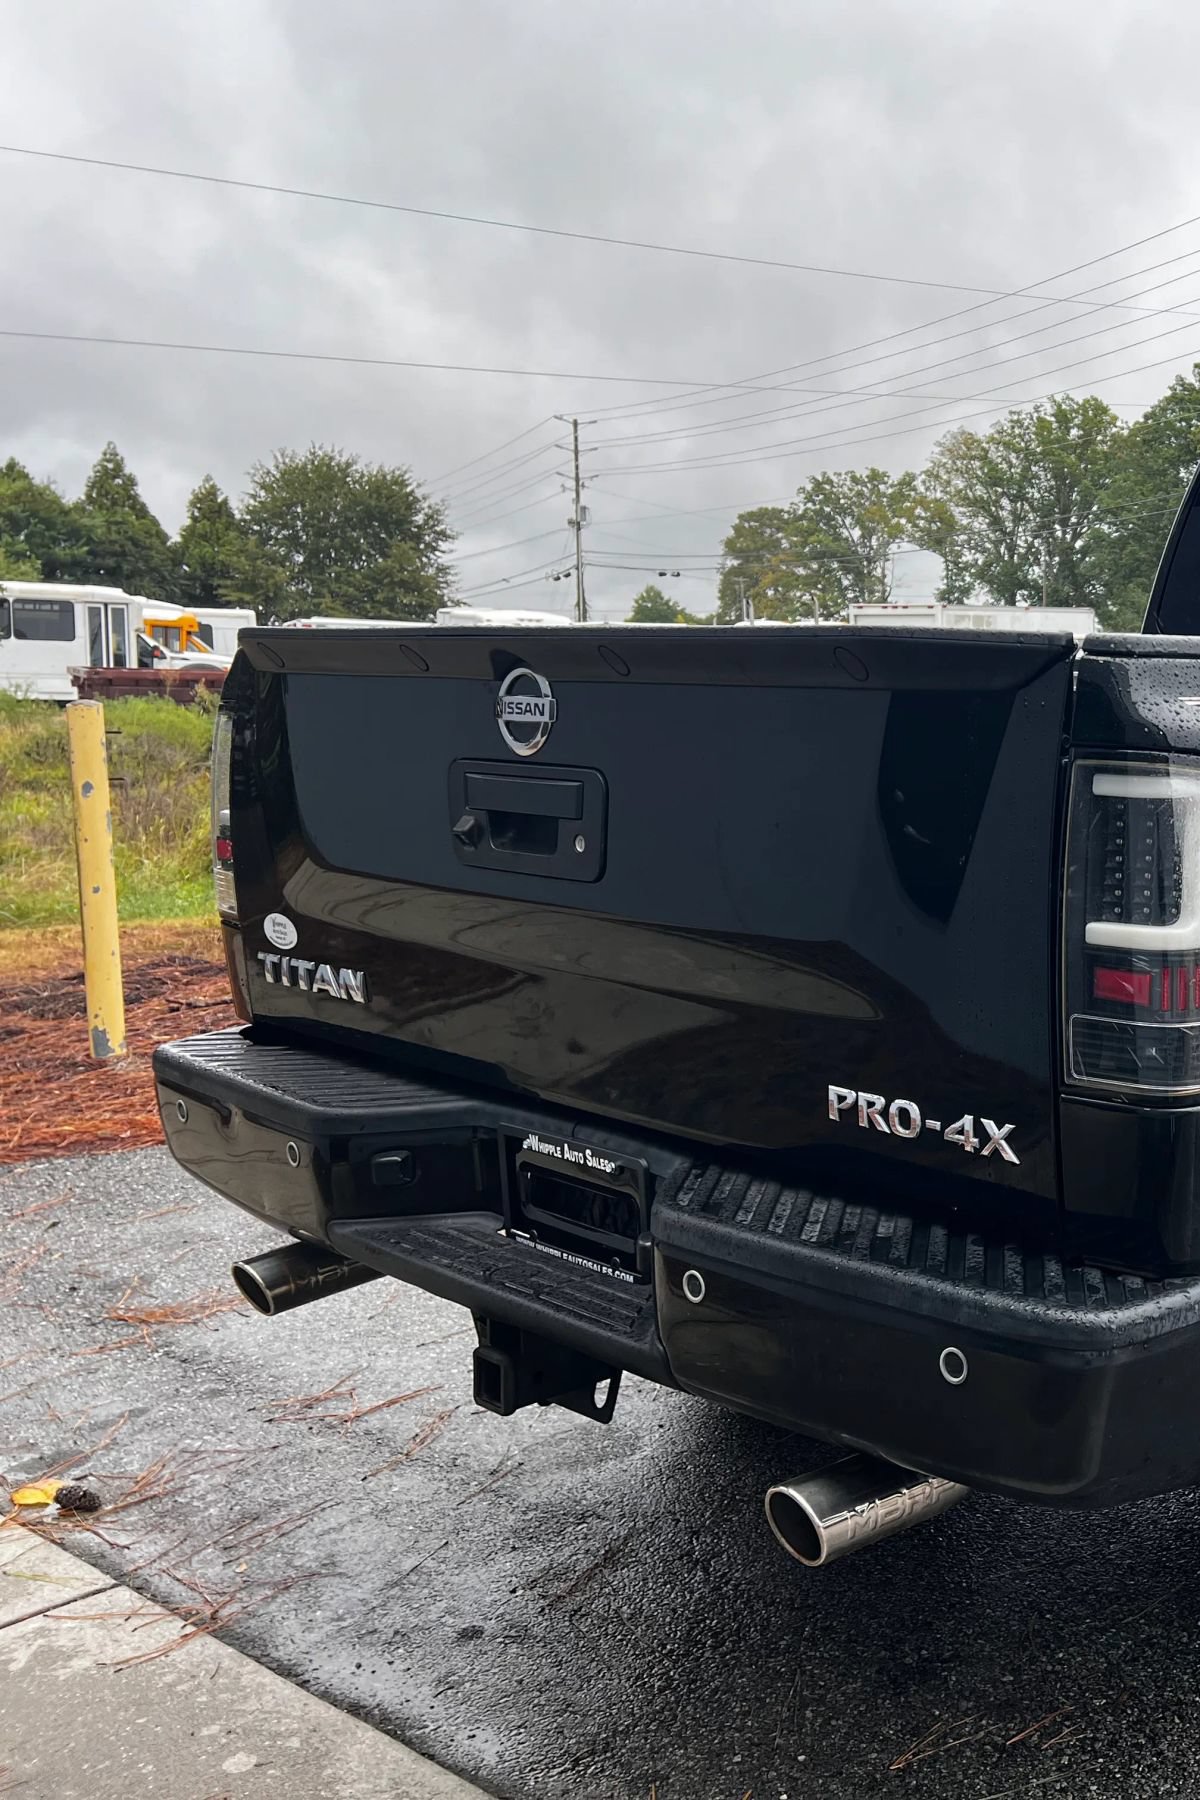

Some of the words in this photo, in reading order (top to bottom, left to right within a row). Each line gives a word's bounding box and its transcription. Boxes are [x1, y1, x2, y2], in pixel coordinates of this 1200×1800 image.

[496, 700, 545, 718] NISSAN
[257, 951, 366, 1004] TITAN
[828, 1084, 1020, 1164] PRO-4X
[529, 1133, 562, 1159] WHIPPLE
[564, 1143, 584, 1165] AUTO
[585, 1149, 610, 1171] SALES
[515, 1236, 634, 1284] WWWWHIPPLEAUTOSALES.COM
